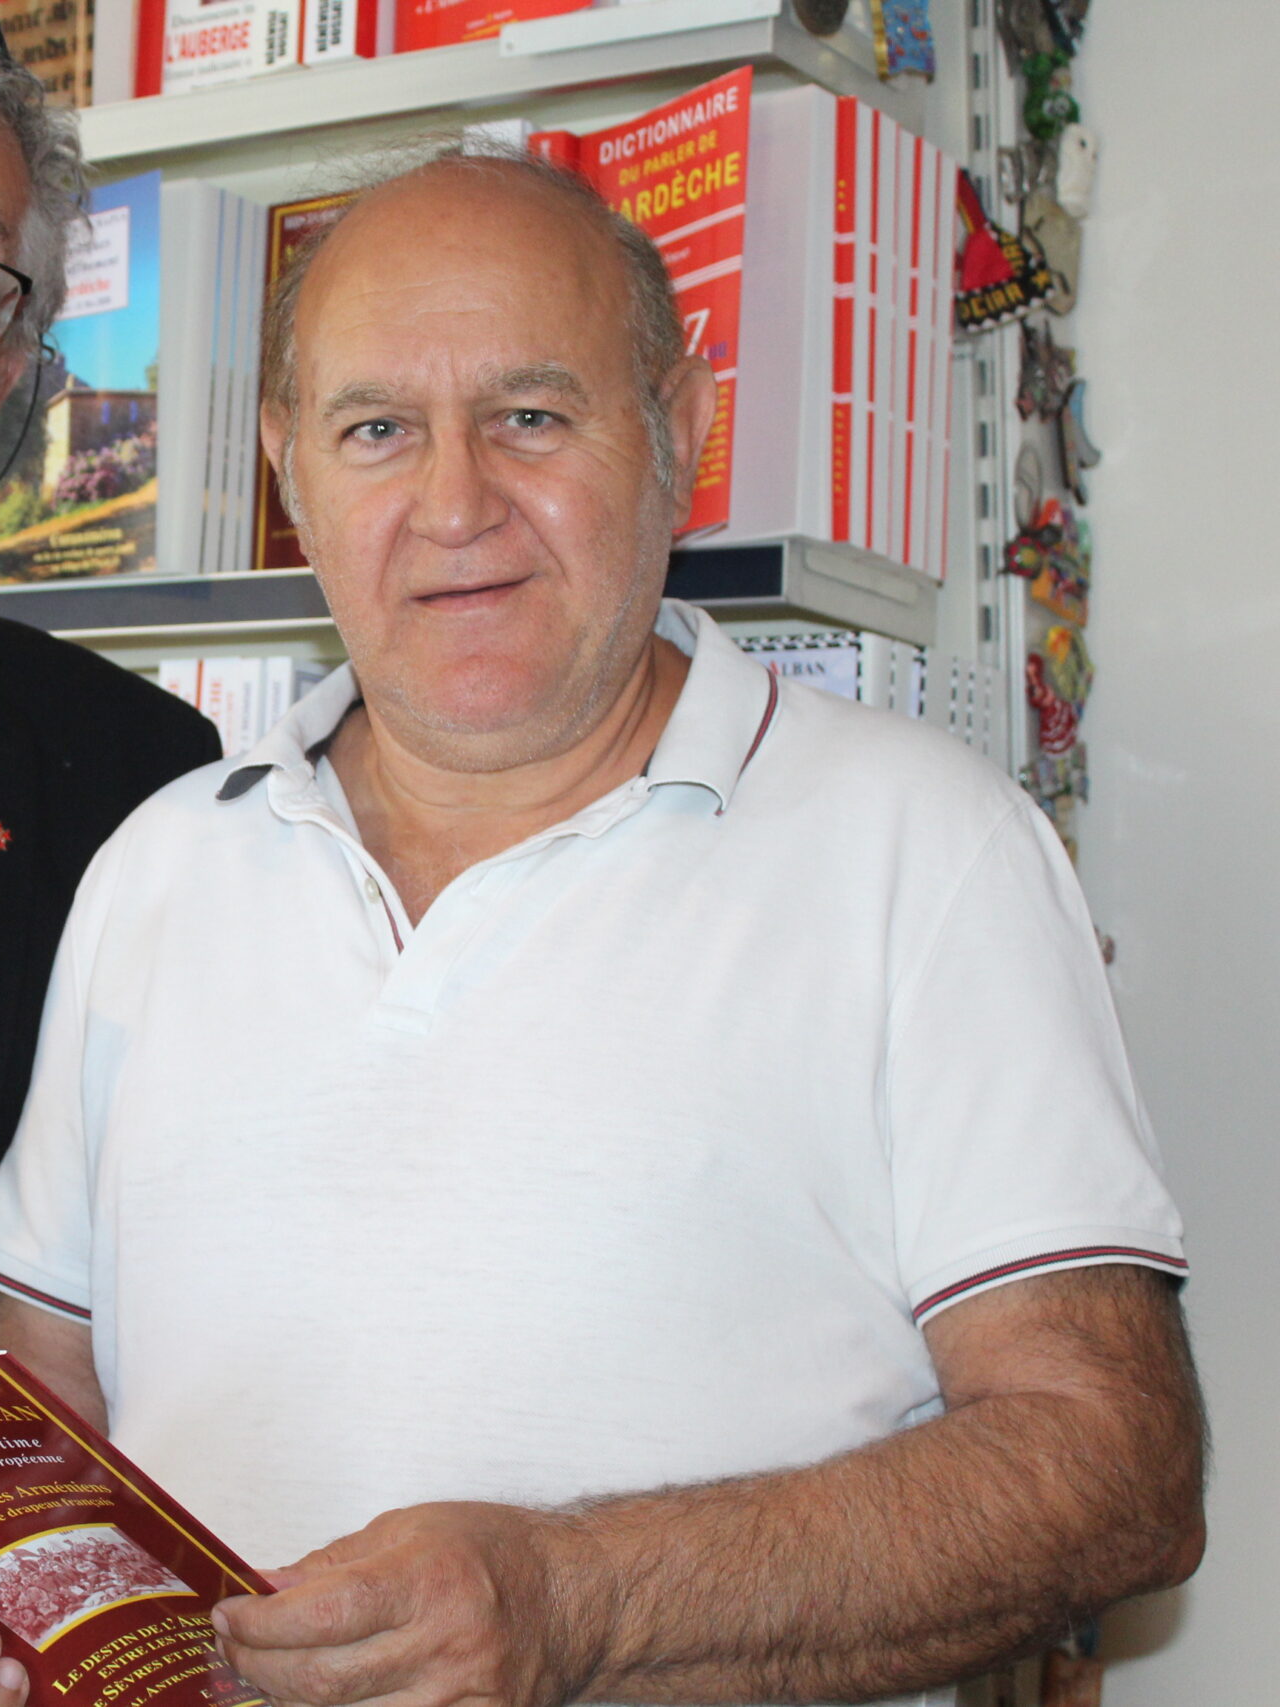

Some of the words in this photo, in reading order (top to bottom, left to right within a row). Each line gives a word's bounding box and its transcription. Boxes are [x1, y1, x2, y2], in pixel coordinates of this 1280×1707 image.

[599, 86, 739, 165] DICTIONNAIRE
[619, 165, 640, 186] DU
[643, 140, 696, 176] PARLER
[698, 129, 718, 153] DE
[7, 1498, 62, 1518] drapeau
[61, 1496, 115, 1508] français
[15, 1480, 112, 1500] Arméniens
[51, 1668, 83, 1696] LE
[80, 1631, 140, 1672] DESTIN
[137, 1624, 163, 1639] DE
[96, 1645, 150, 1680] ENTRE
[146, 1635, 177, 1651] LES
[101, 1658, 164, 1701] SÈVRES
[162, 1651, 184, 1665] ET
[185, 1645, 207, 1658] DE
[145, 1663, 210, 1697] ANTRANIK
